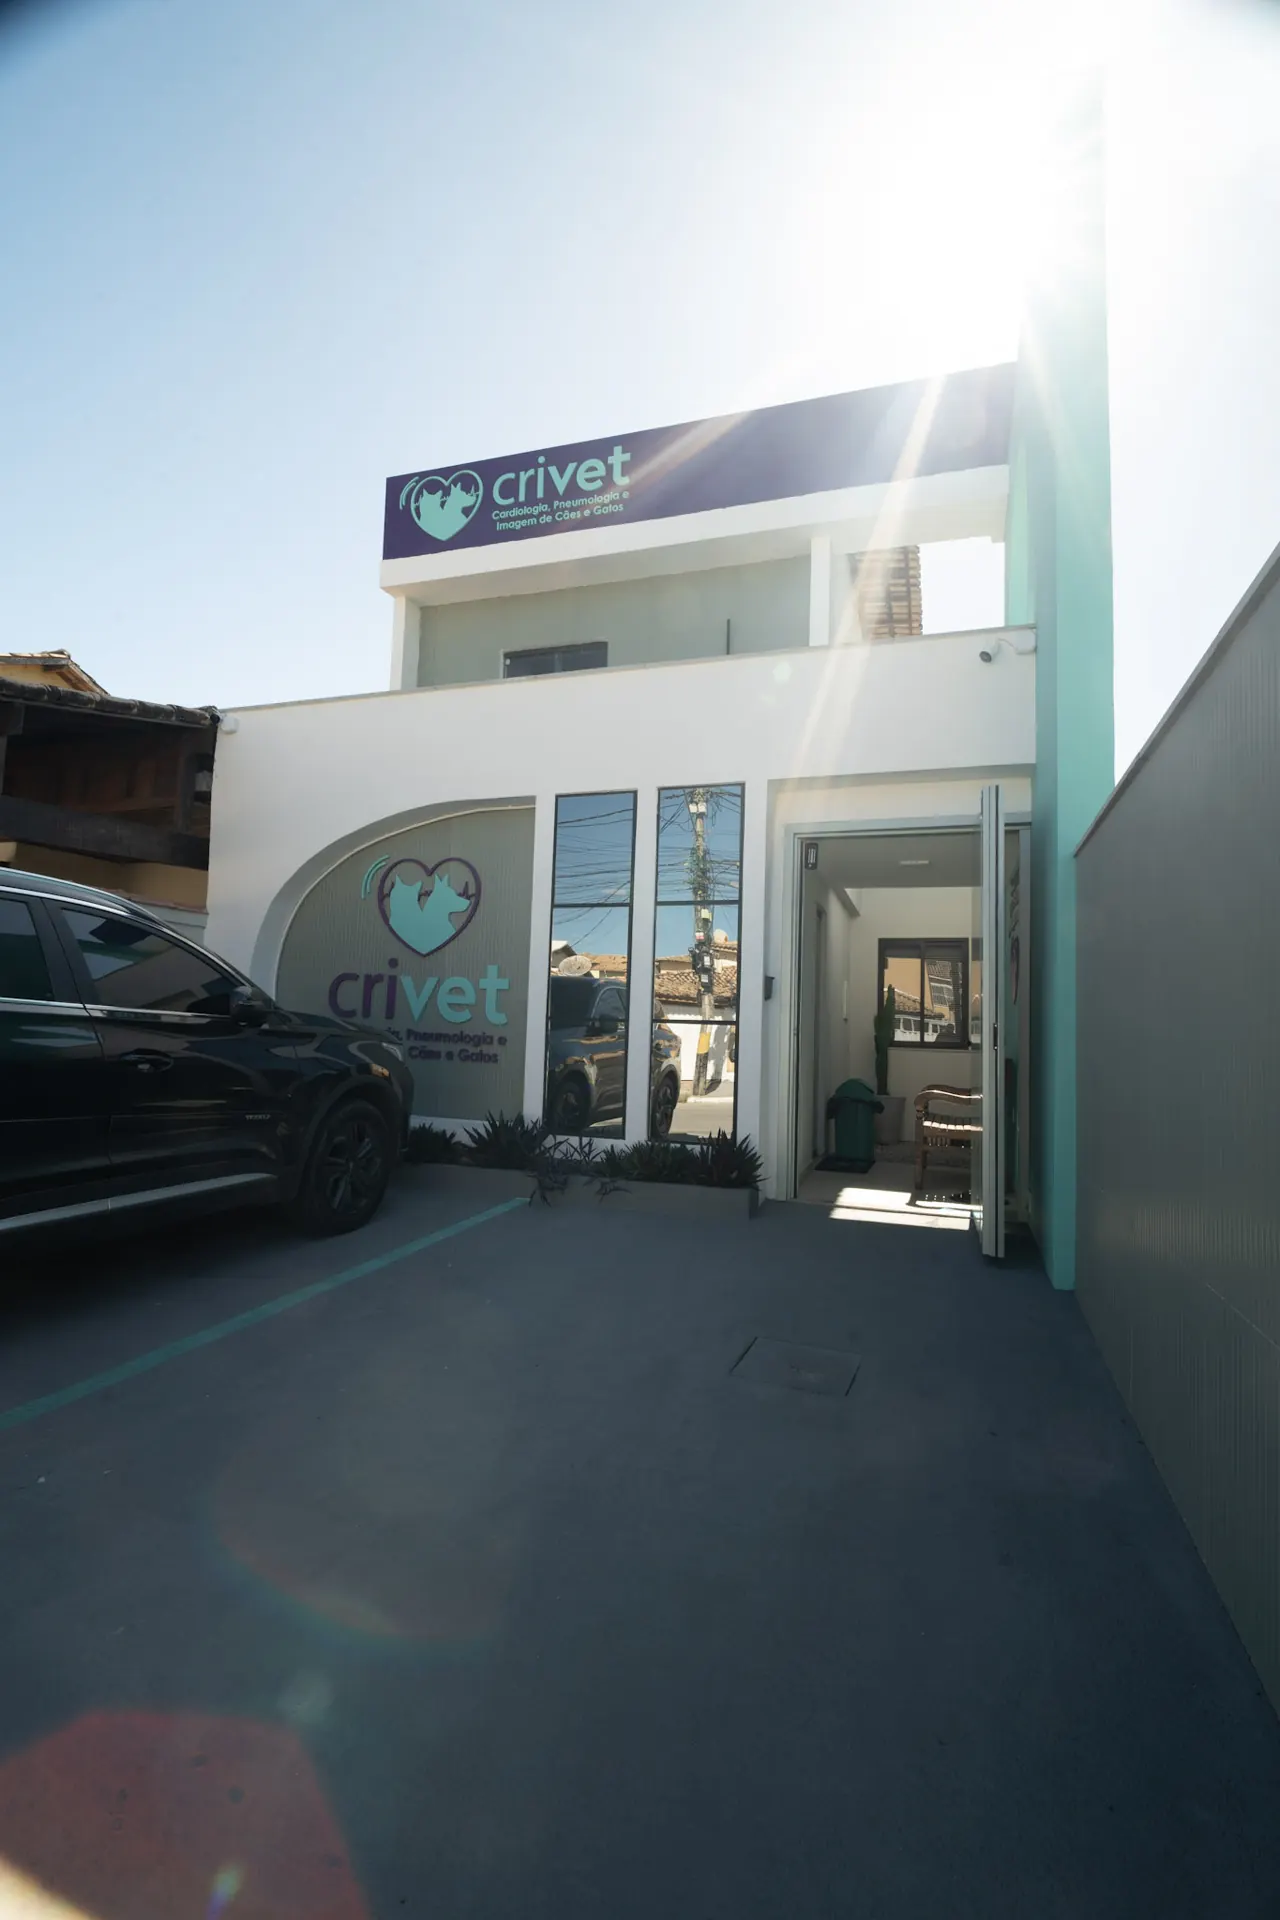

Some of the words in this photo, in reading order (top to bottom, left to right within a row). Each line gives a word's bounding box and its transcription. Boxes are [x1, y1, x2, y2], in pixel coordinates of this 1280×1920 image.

[492, 445, 631, 505] crivet
[492, 503, 551, 520] Cardiologia,
[553, 491, 620, 510] Pneumologia
[622, 490, 630, 499] e
[496, 516, 537, 531] Imagem
[539, 514, 553, 524] de
[555, 510, 581, 521] Cães
[583, 508, 591, 517] e
[593, 503, 624, 515] Gatos
[328, 957, 510, 1026] crivet
[406, 1028, 494, 1047] Pneumologia
[497, 1035, 508, 1046] e
[458, 1048, 499, 1063] Gatos
